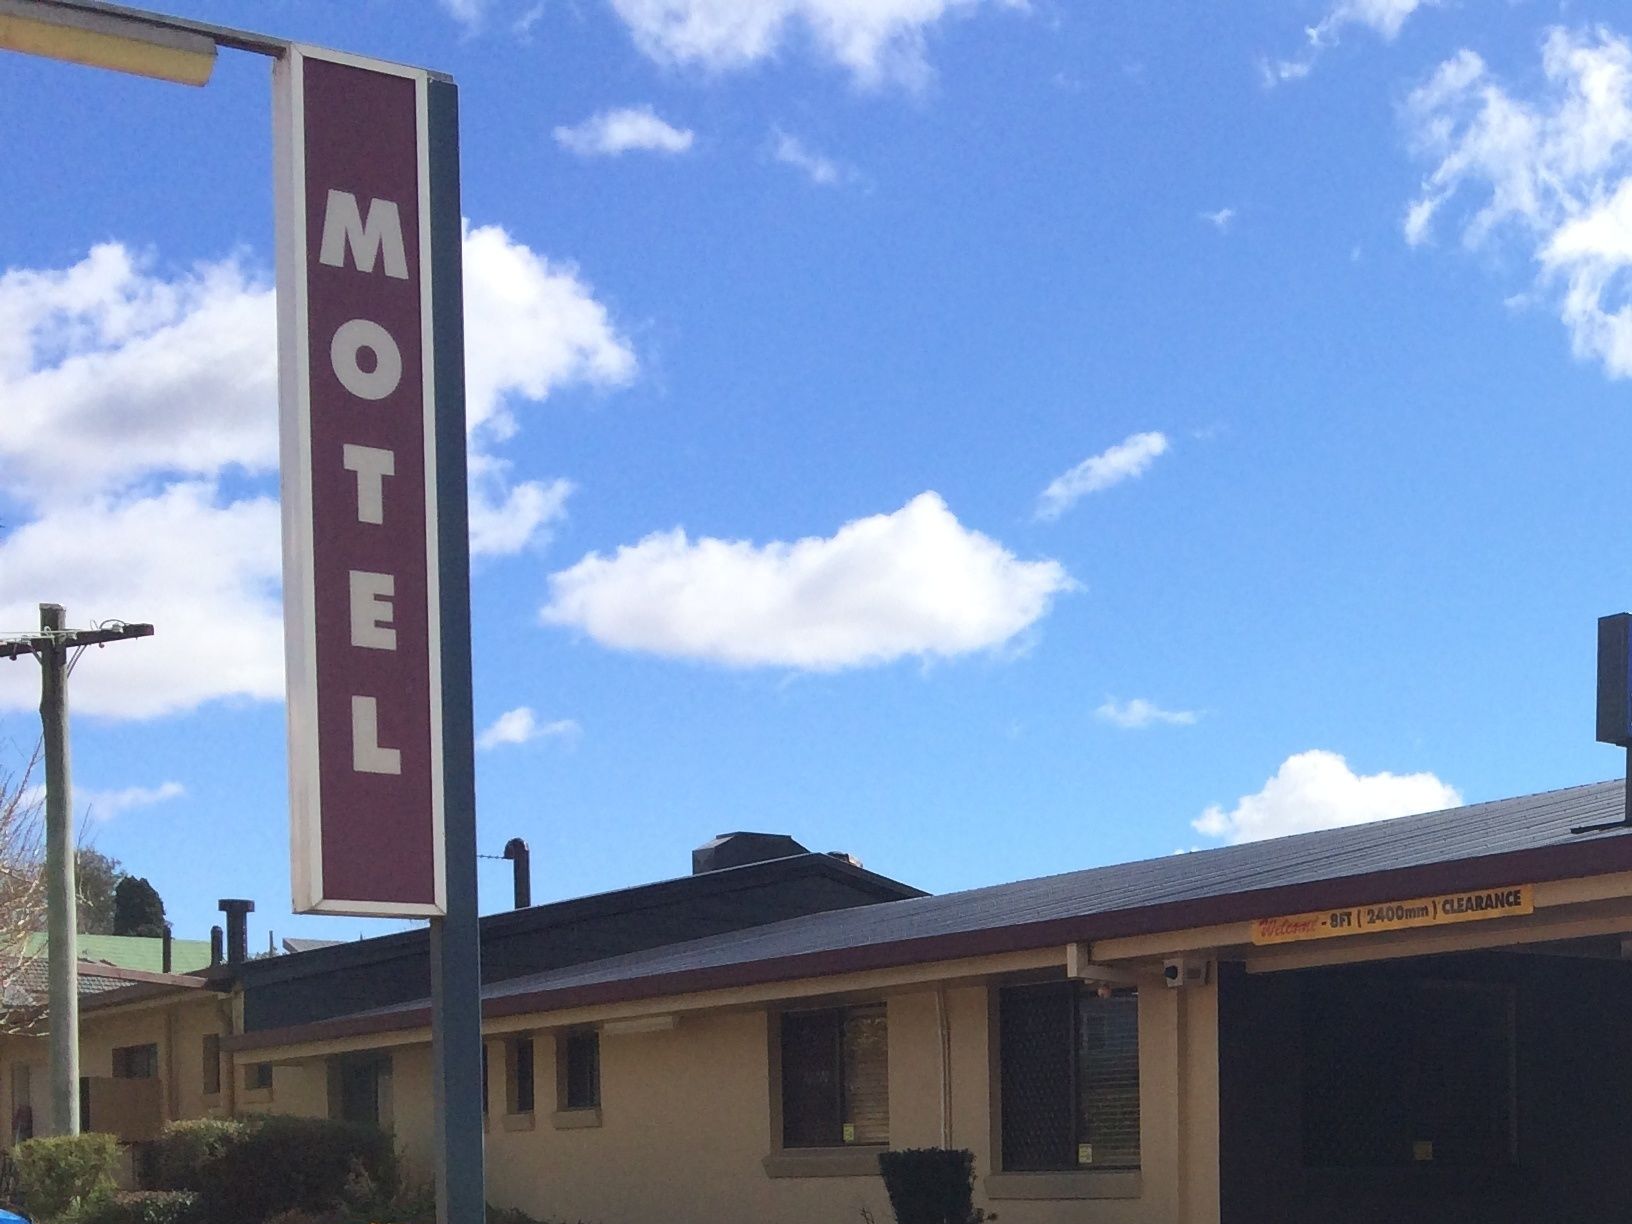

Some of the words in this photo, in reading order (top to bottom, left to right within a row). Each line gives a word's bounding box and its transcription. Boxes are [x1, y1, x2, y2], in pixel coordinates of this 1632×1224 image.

[319, 188, 409, 775] MOTEL
[1330, 911, 1352, 928] 8FT
[1442, 890, 1521, 915] CLEARANCE
